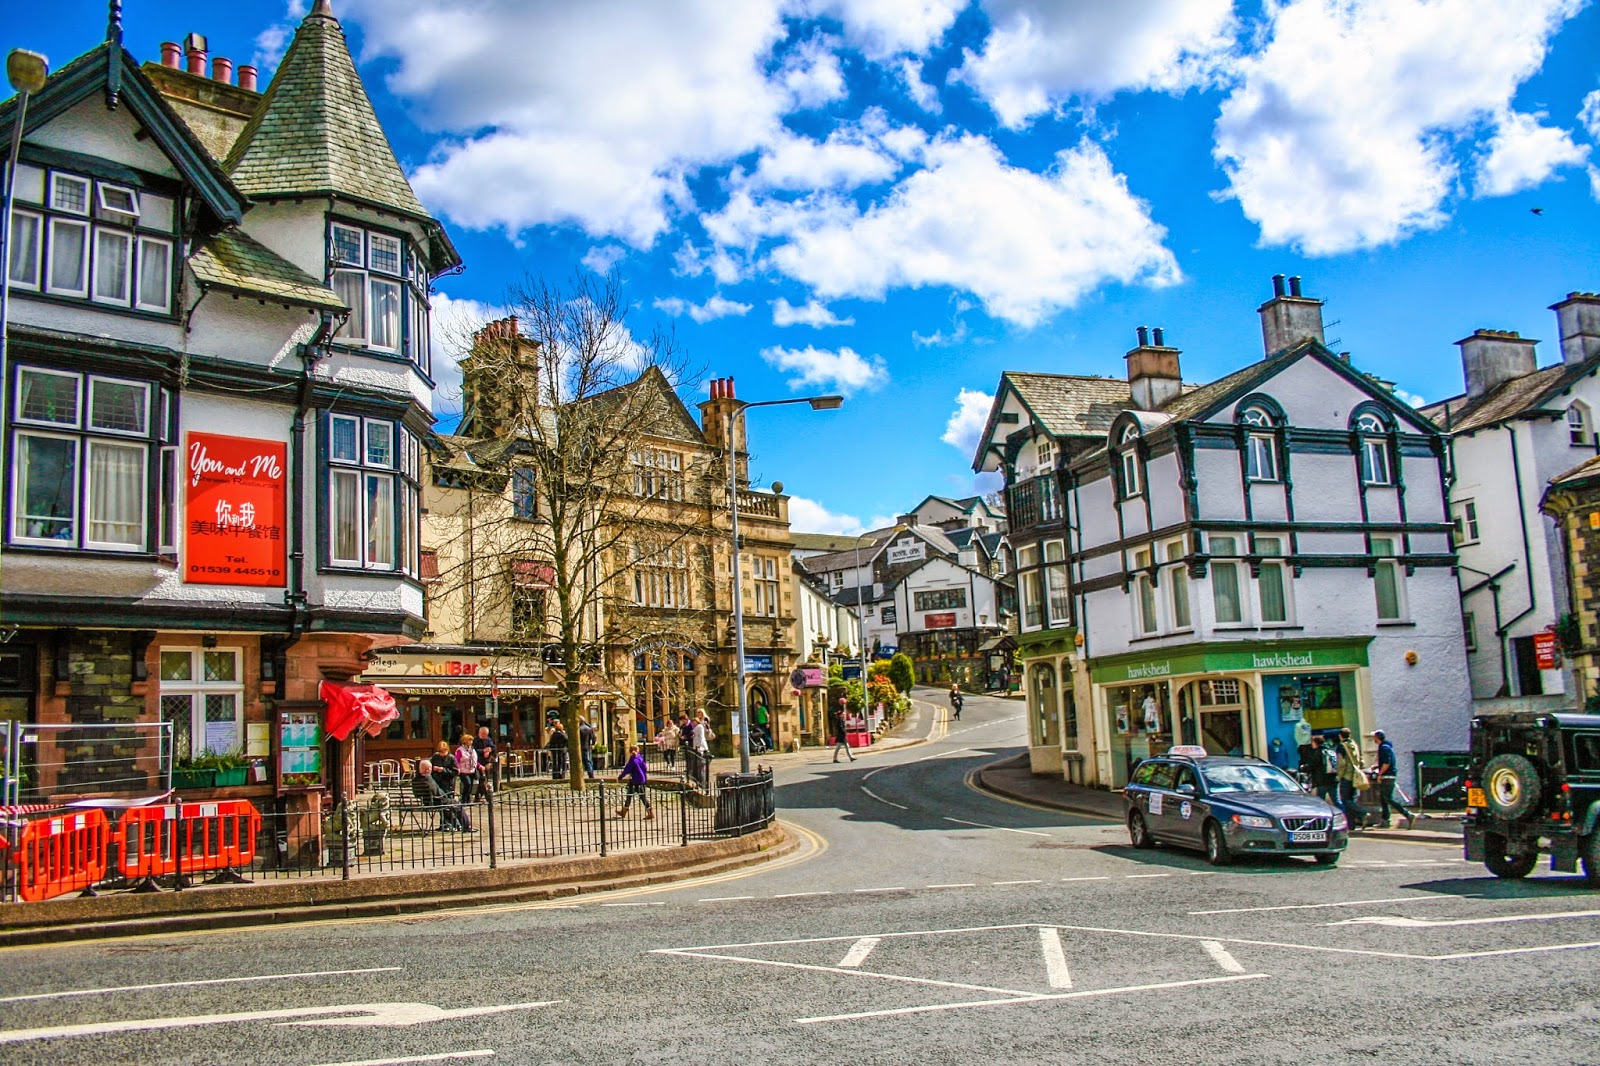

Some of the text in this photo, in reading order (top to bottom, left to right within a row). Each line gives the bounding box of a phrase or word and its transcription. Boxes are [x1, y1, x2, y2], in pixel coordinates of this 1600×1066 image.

[190, 442, 282, 487] You and Me
[225, 555, 248, 564] Tel.
[191, 565, 280, 576] 01539 445510
[371, 657, 397, 668] odega
[1253, 651, 1312, 668] hawkshead
[422, 660, 478, 675] SolBar
[1127, 660, 1170, 678] hawkshead
[405, 687, 420, 695] WINE
[421, 687, 435, 695] BAR
